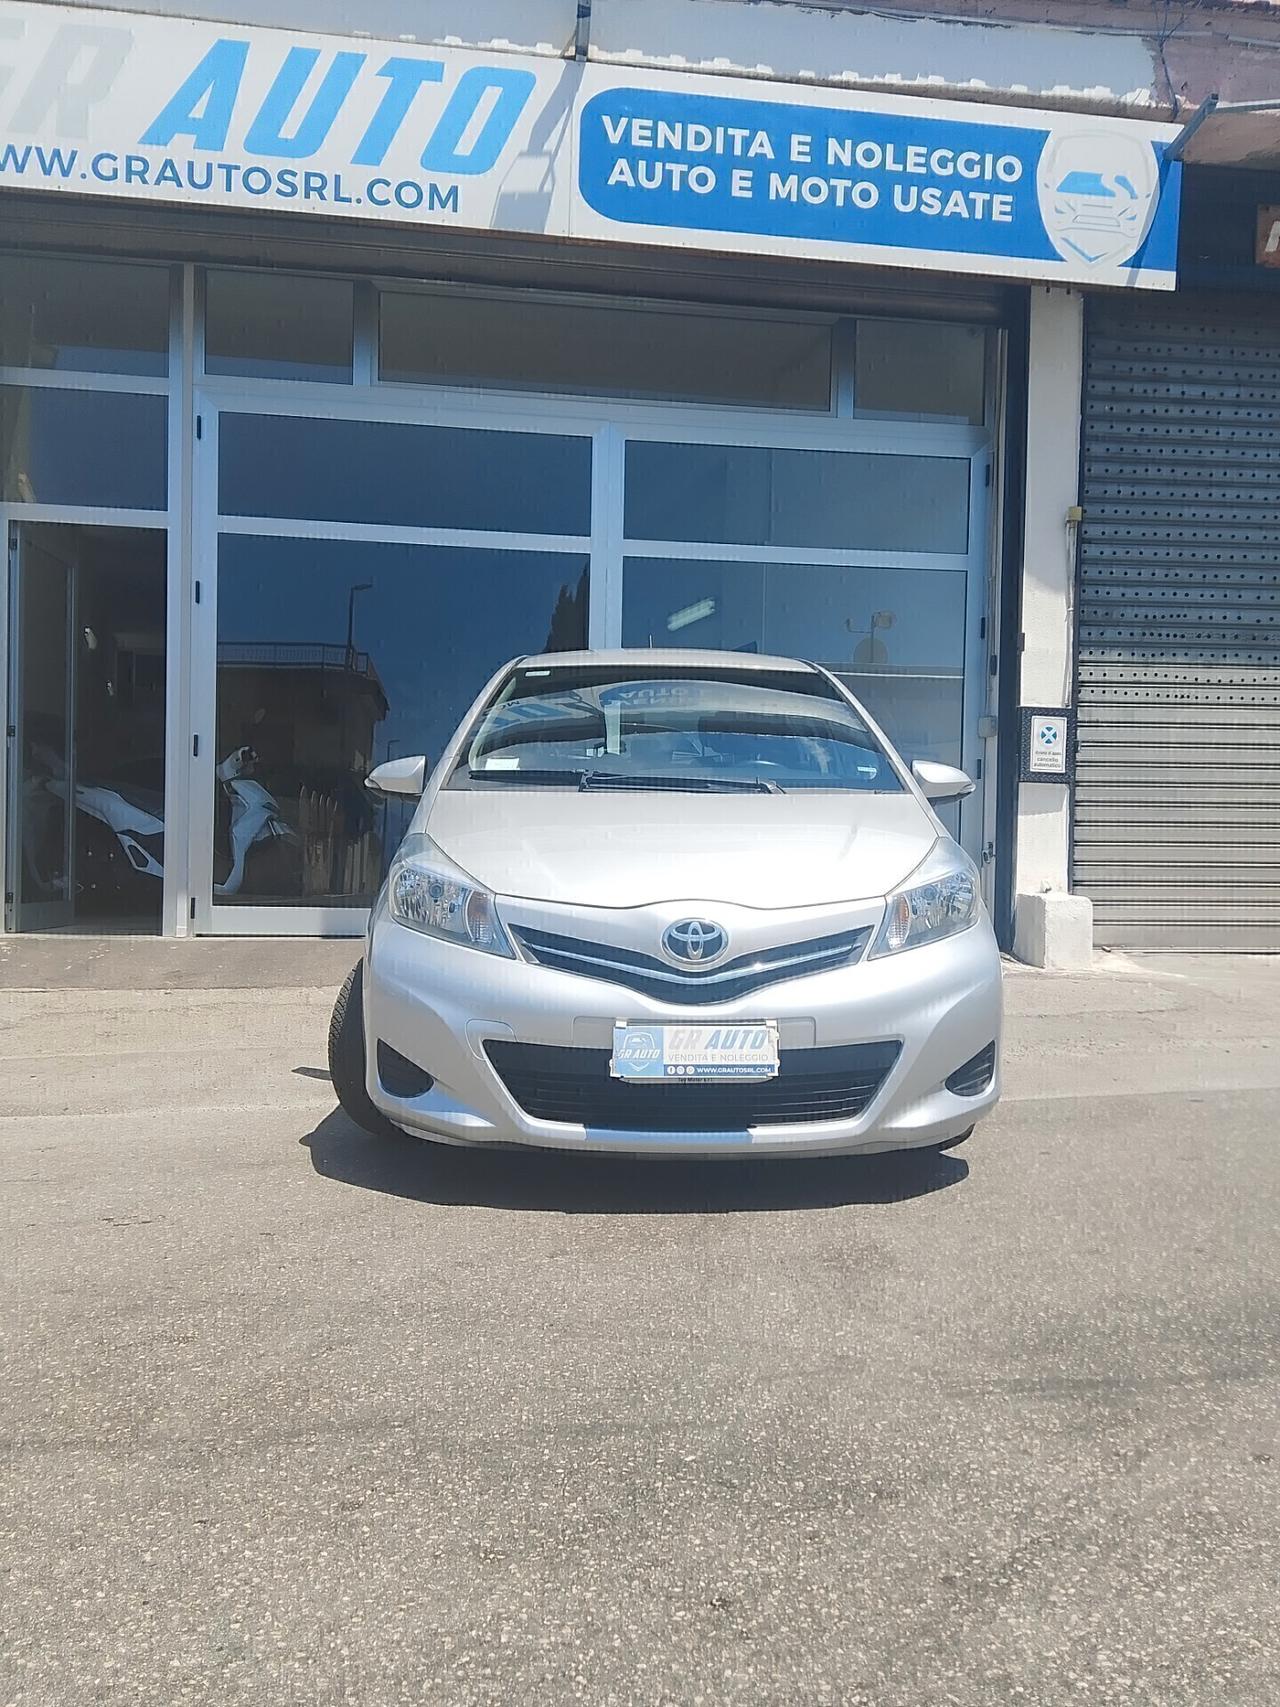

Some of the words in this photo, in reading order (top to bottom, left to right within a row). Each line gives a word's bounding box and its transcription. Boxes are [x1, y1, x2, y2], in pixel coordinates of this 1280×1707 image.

[138, 39, 537, 176] AUTO
[601, 115, 775, 160] VENDITA
[790, 133, 812, 163] E
[827, 137, 1023, 183] NOLEGGIO
[607, 158, 716, 194] AUTO
[731, 168, 753, 198] E
[769, 172, 879, 209] MOTO
[893, 184, 1013, 222] USATE
[634, 1048, 661, 1059] AUTO
[668, 1029, 703, 1050] GR
[703, 1029, 769, 1050] AUTO
[668, 1054, 708, 1062] VENDITA
[711, 1053, 717, 1062] E
[719, 1053, 769, 1062] NOLEGGIO
